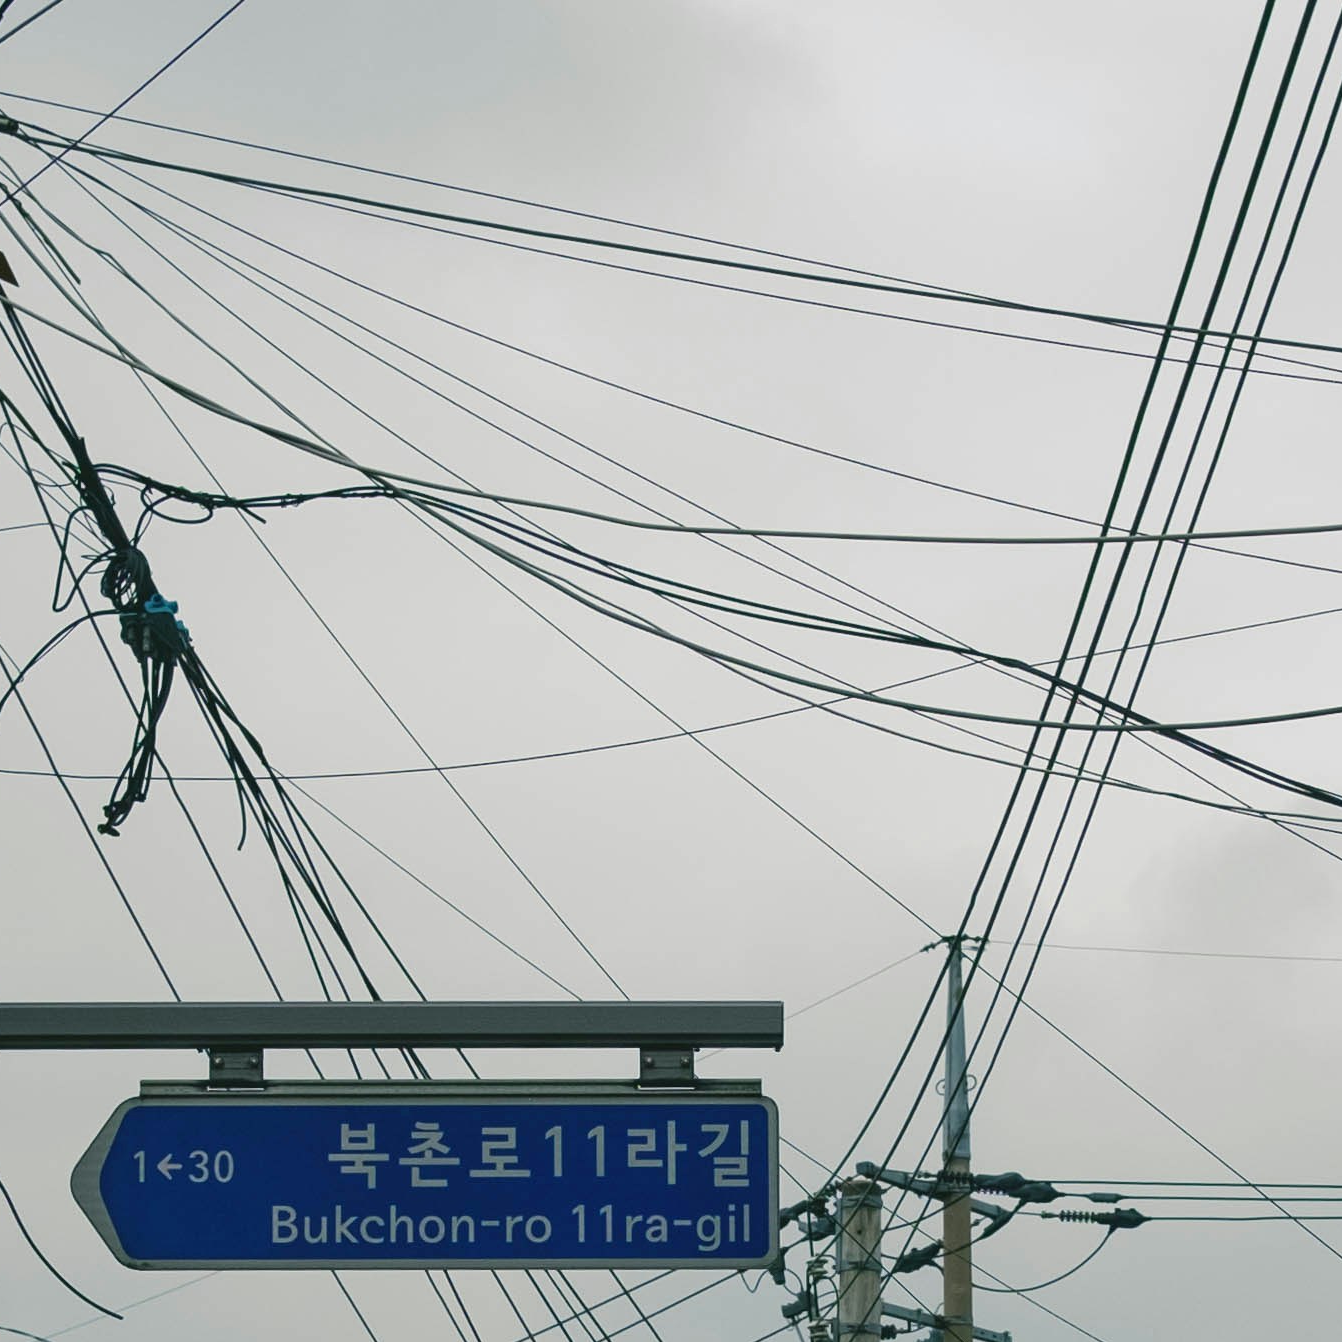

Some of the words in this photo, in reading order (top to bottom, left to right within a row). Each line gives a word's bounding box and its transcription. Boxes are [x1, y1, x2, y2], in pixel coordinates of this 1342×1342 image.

[327, 1119, 750, 1190] 북촌로11라길
[271, 1204, 552, 1244] Bukchon-ro
[571, 1203, 750, 1252] 11ra-gil
